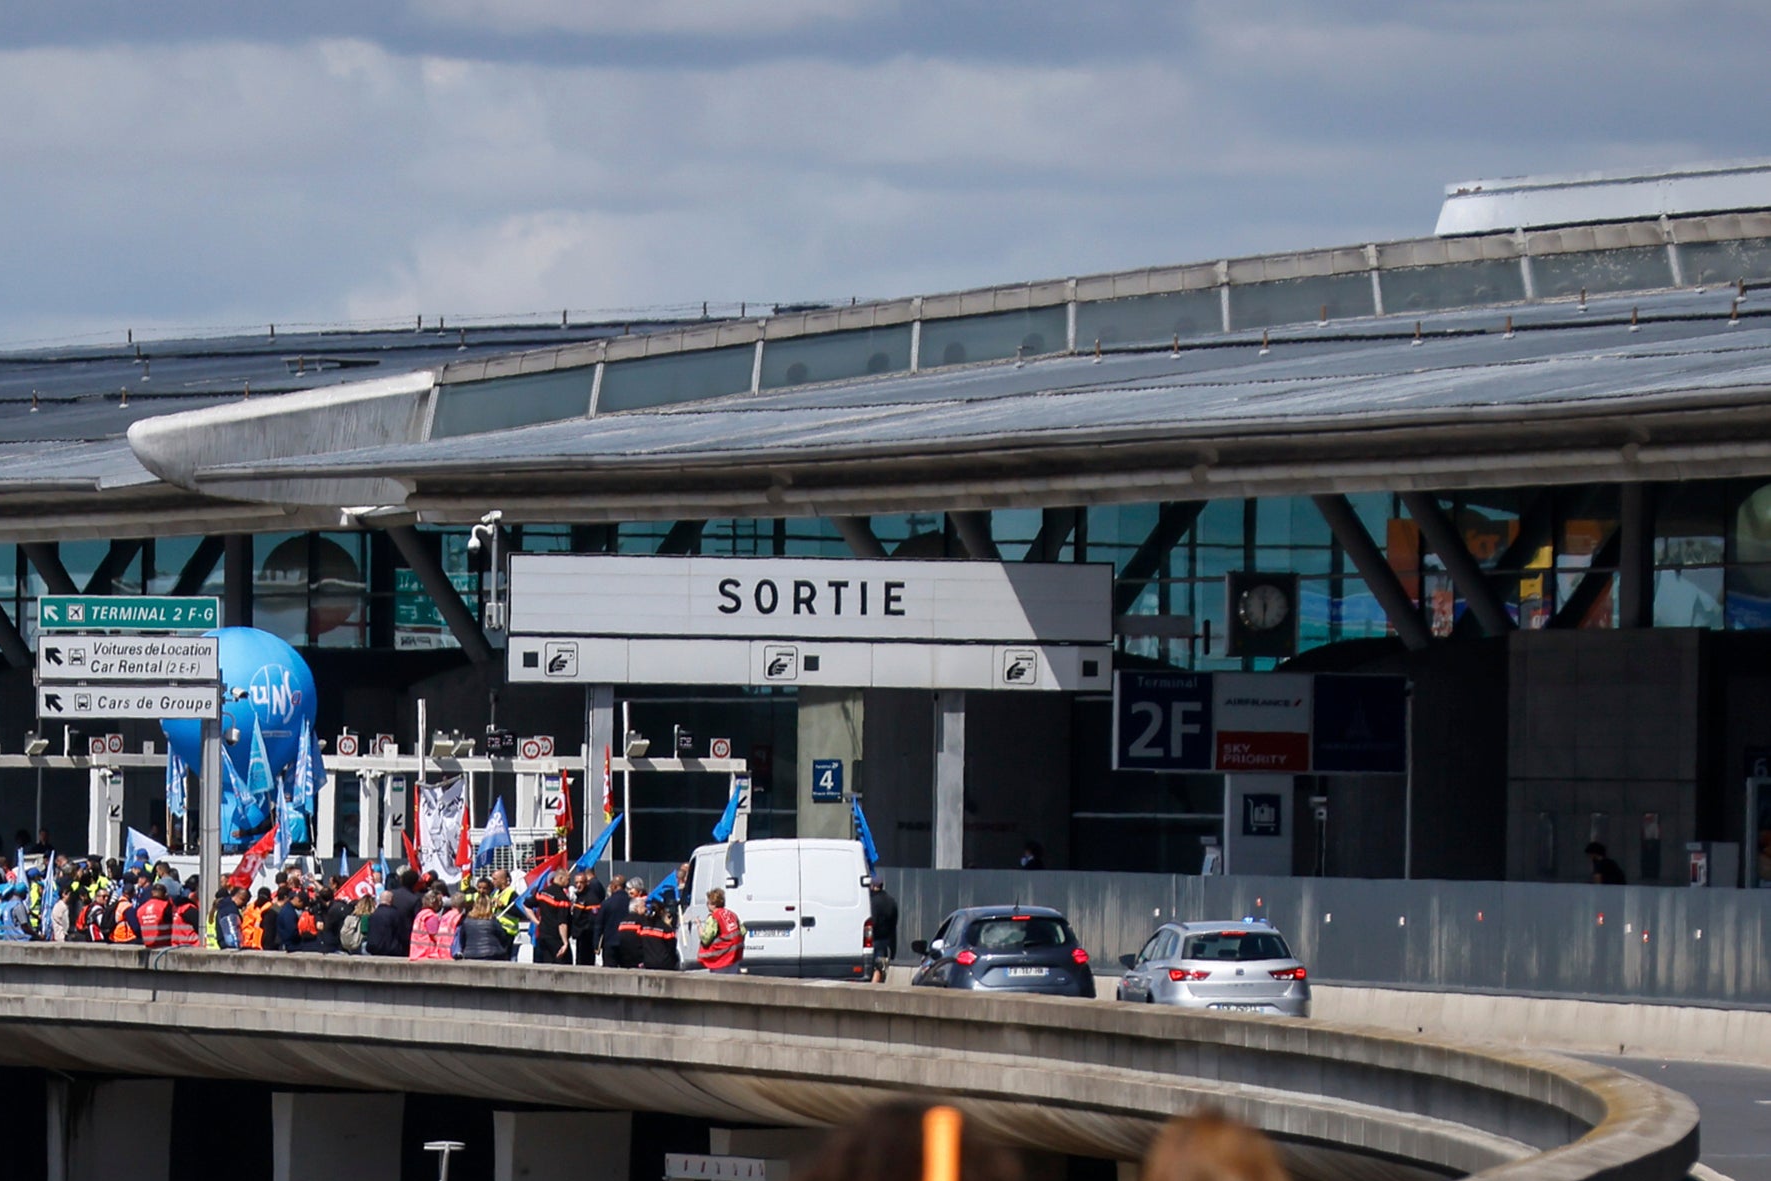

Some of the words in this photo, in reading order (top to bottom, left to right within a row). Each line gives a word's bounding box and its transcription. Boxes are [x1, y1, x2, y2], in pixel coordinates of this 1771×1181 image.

[718, 578, 905, 616] SORTIE
[91, 606, 167, 621] TERMINAL
[172, 607, 182, 621] 2
[188, 607, 214, 621] F-G
[93, 641, 144, 656] Voitures
[145, 642, 160, 656] de
[161, 642, 212, 657] Location
[91, 660, 114, 673] Car
[118, 660, 162, 673] Rental
[1137, 676, 1198, 689] Terminal
[98, 696, 130, 709] Cars
[137, 696, 153, 709] de
[160, 696, 212, 713] Groupe
[1128, 700, 1202, 758] 2F
[1223, 743, 1252, 753] SKY
[1223, 754, 1287, 765] PRIORITY
[819, 769, 834, 790] 4
